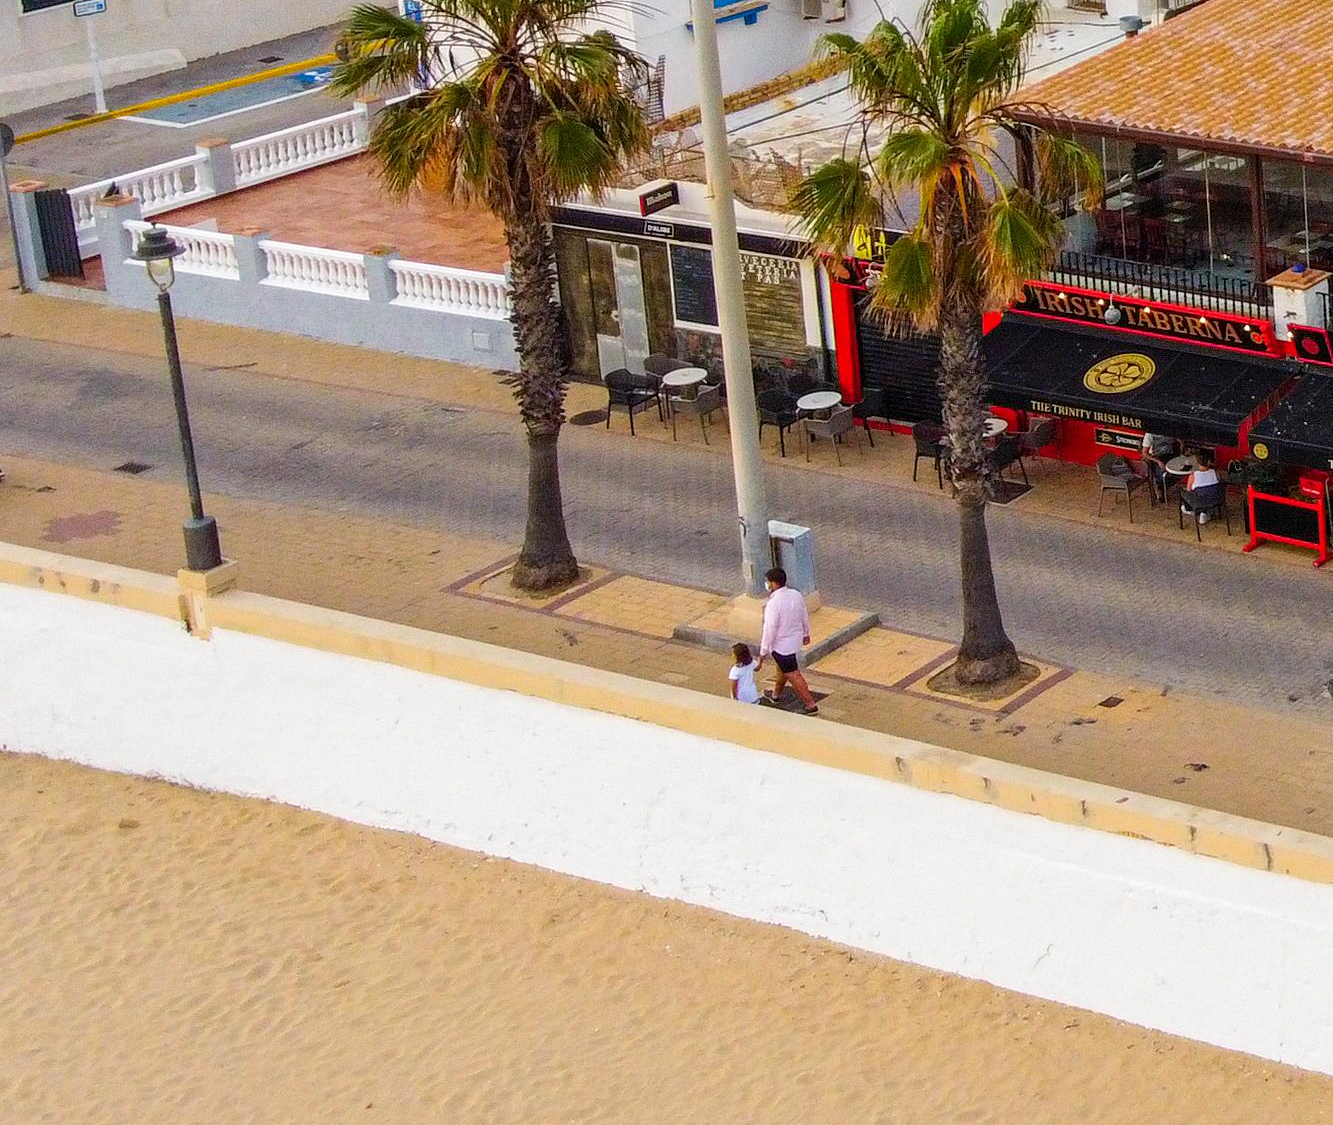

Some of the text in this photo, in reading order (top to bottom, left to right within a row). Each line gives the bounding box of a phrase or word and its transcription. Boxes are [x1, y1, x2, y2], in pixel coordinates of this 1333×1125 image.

[1033, 289, 1243, 344] IRISH TABERNA
[1030, 400, 1142, 428] THE TRINITY IRISH BAR
